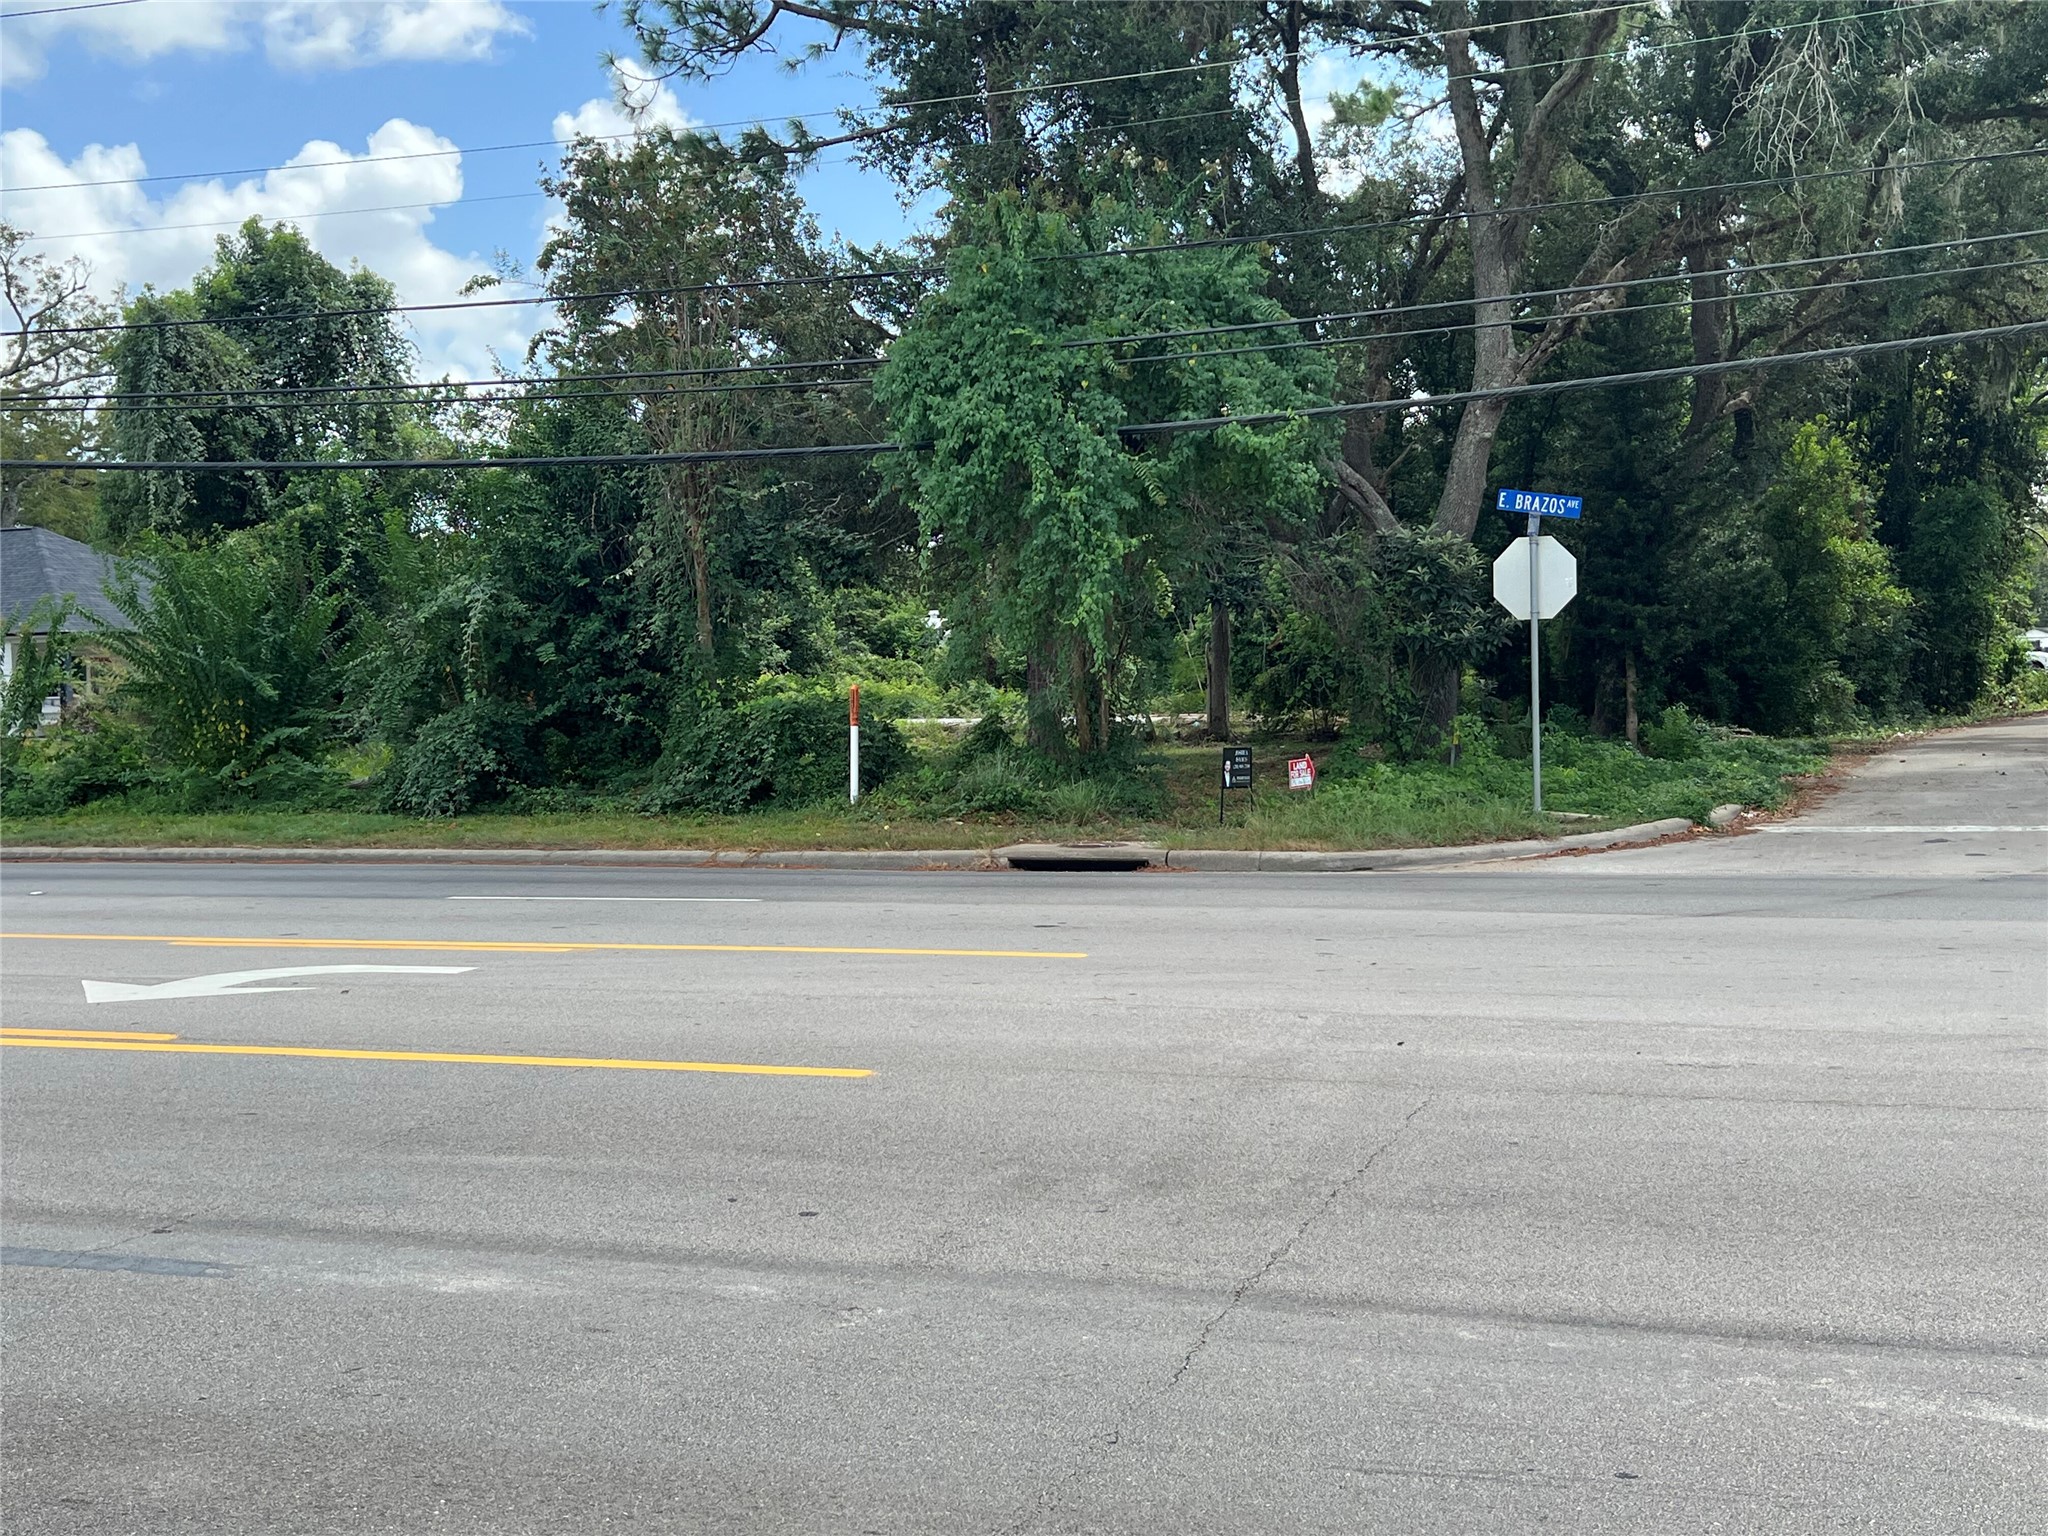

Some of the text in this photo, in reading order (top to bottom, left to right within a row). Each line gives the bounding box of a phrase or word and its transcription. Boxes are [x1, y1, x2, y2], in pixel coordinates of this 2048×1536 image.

[1499, 492, 1579, 514] E. BRAZOS AVE
[1293, 762, 1307, 770] LAND
